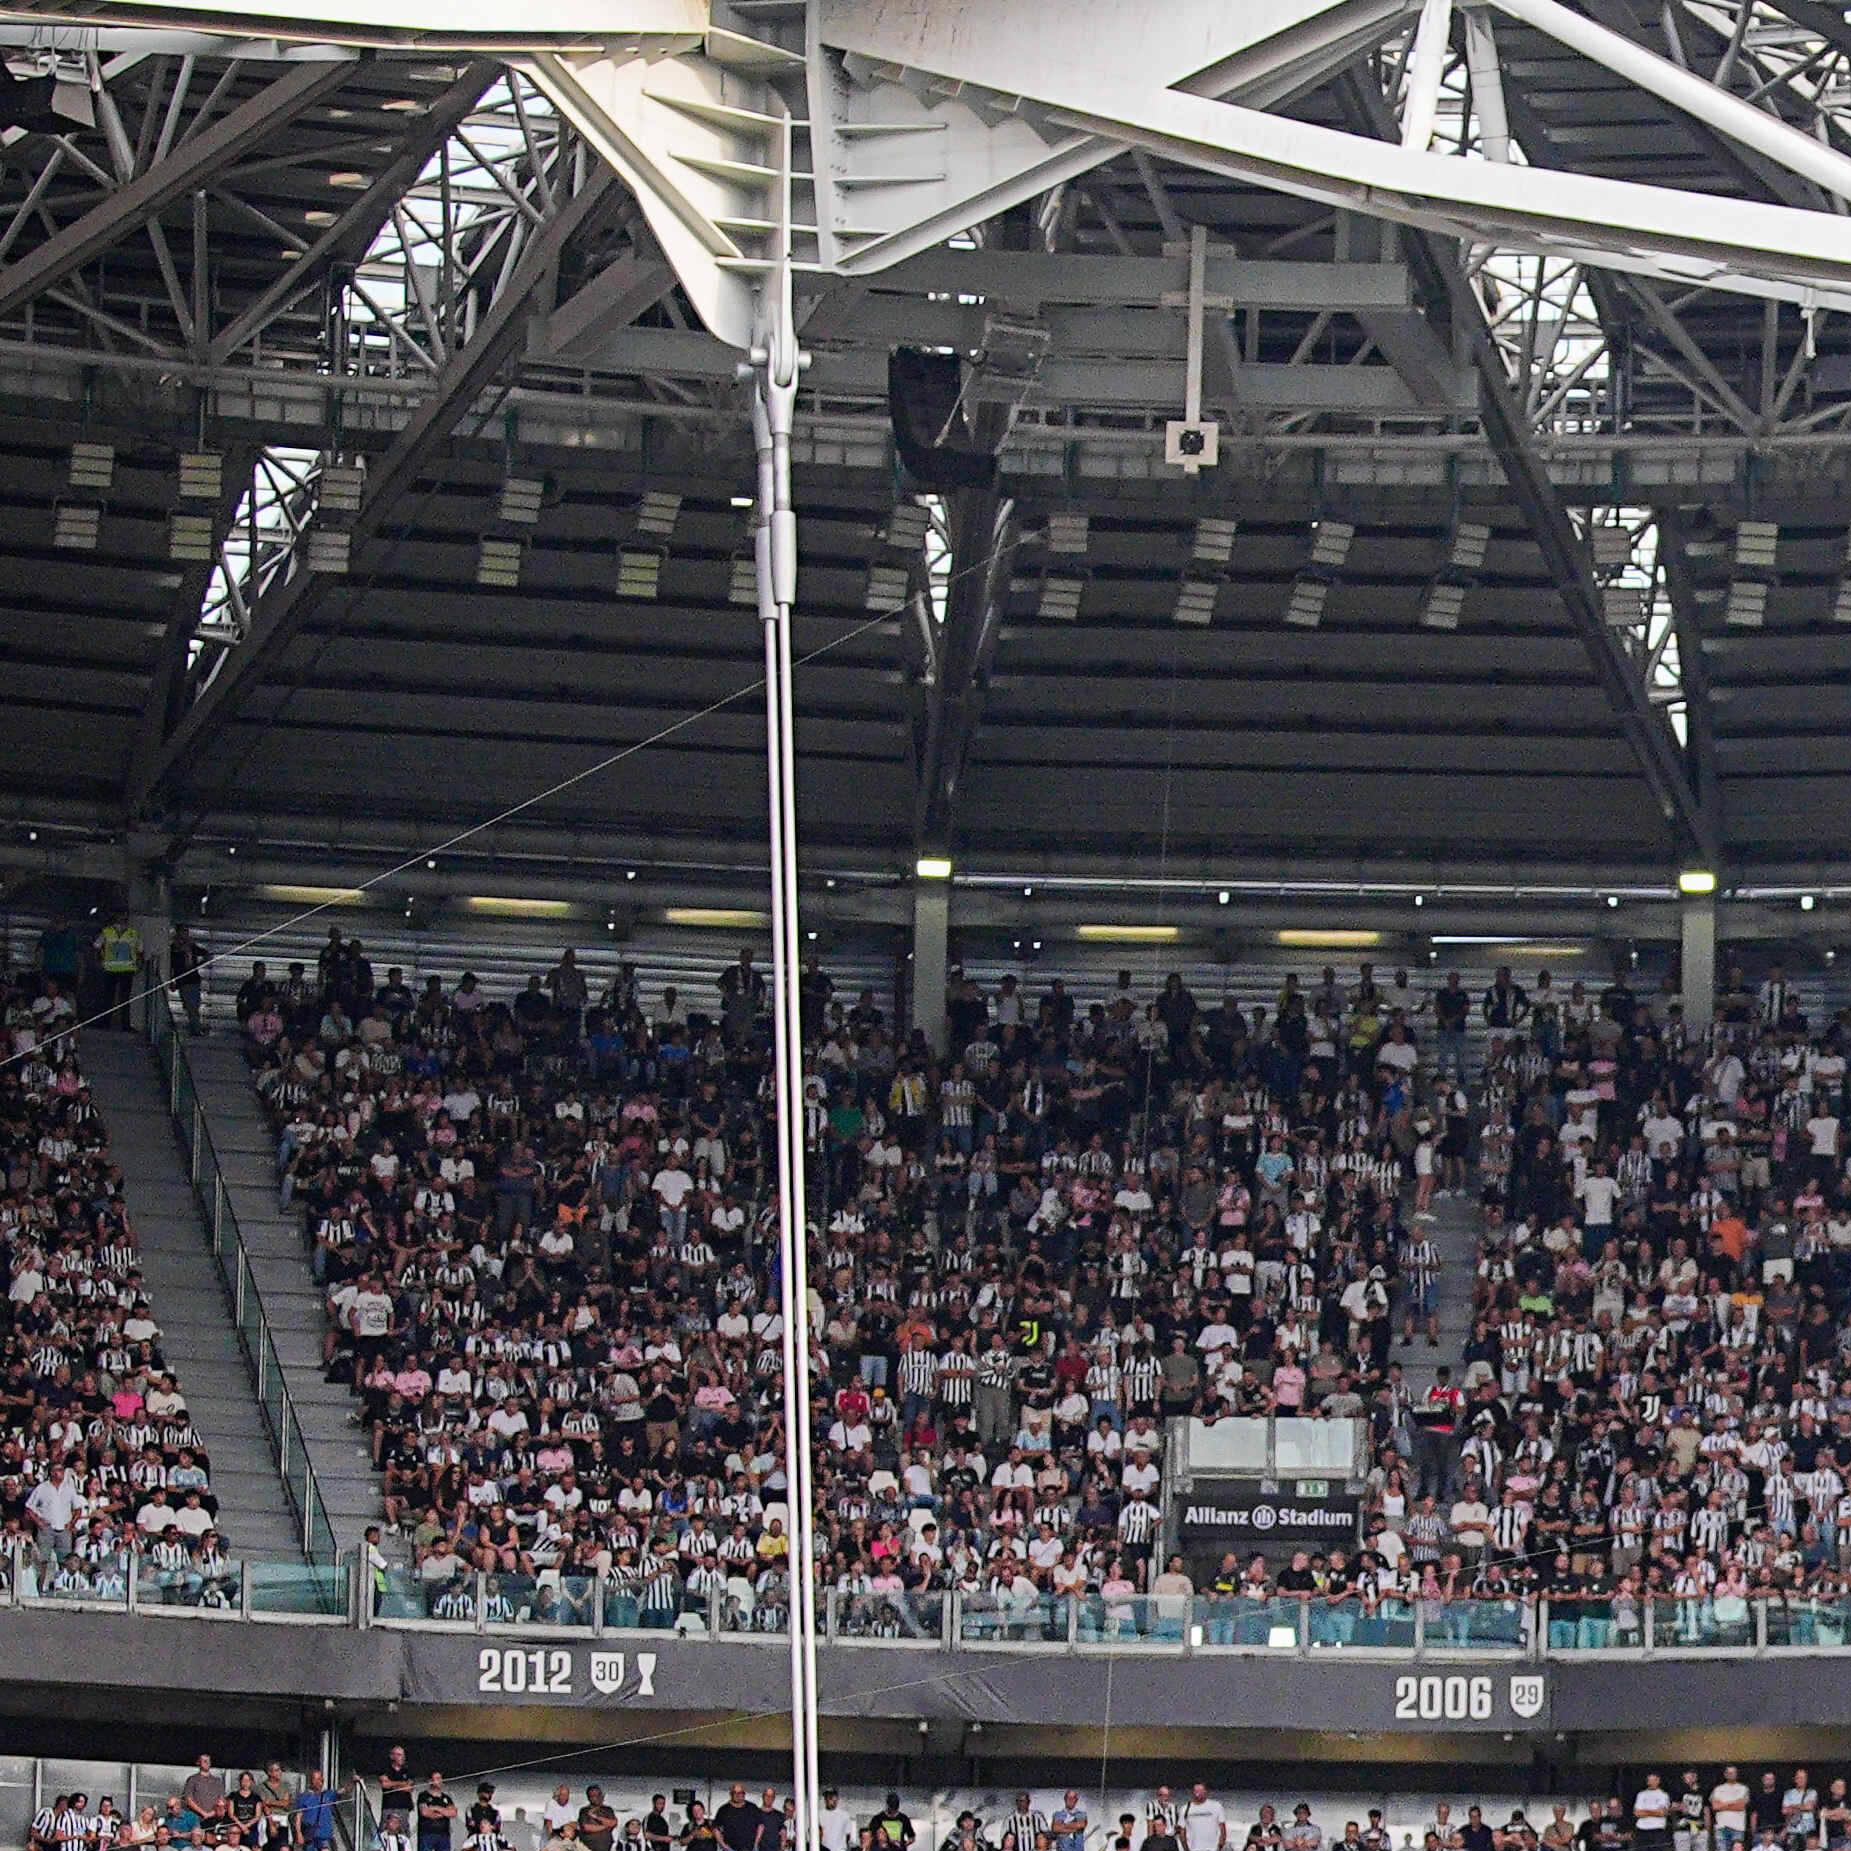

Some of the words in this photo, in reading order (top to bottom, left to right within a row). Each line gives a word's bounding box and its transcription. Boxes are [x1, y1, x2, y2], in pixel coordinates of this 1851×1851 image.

[1185, 1506, 1249, 1525] Allianz
[1277, 1507, 1352, 1526] Stadium
[479, 1649, 572, 1694] 2012
[595, 1661, 619, 1681] 30
[1395, 1676, 1492, 1720] 2006
